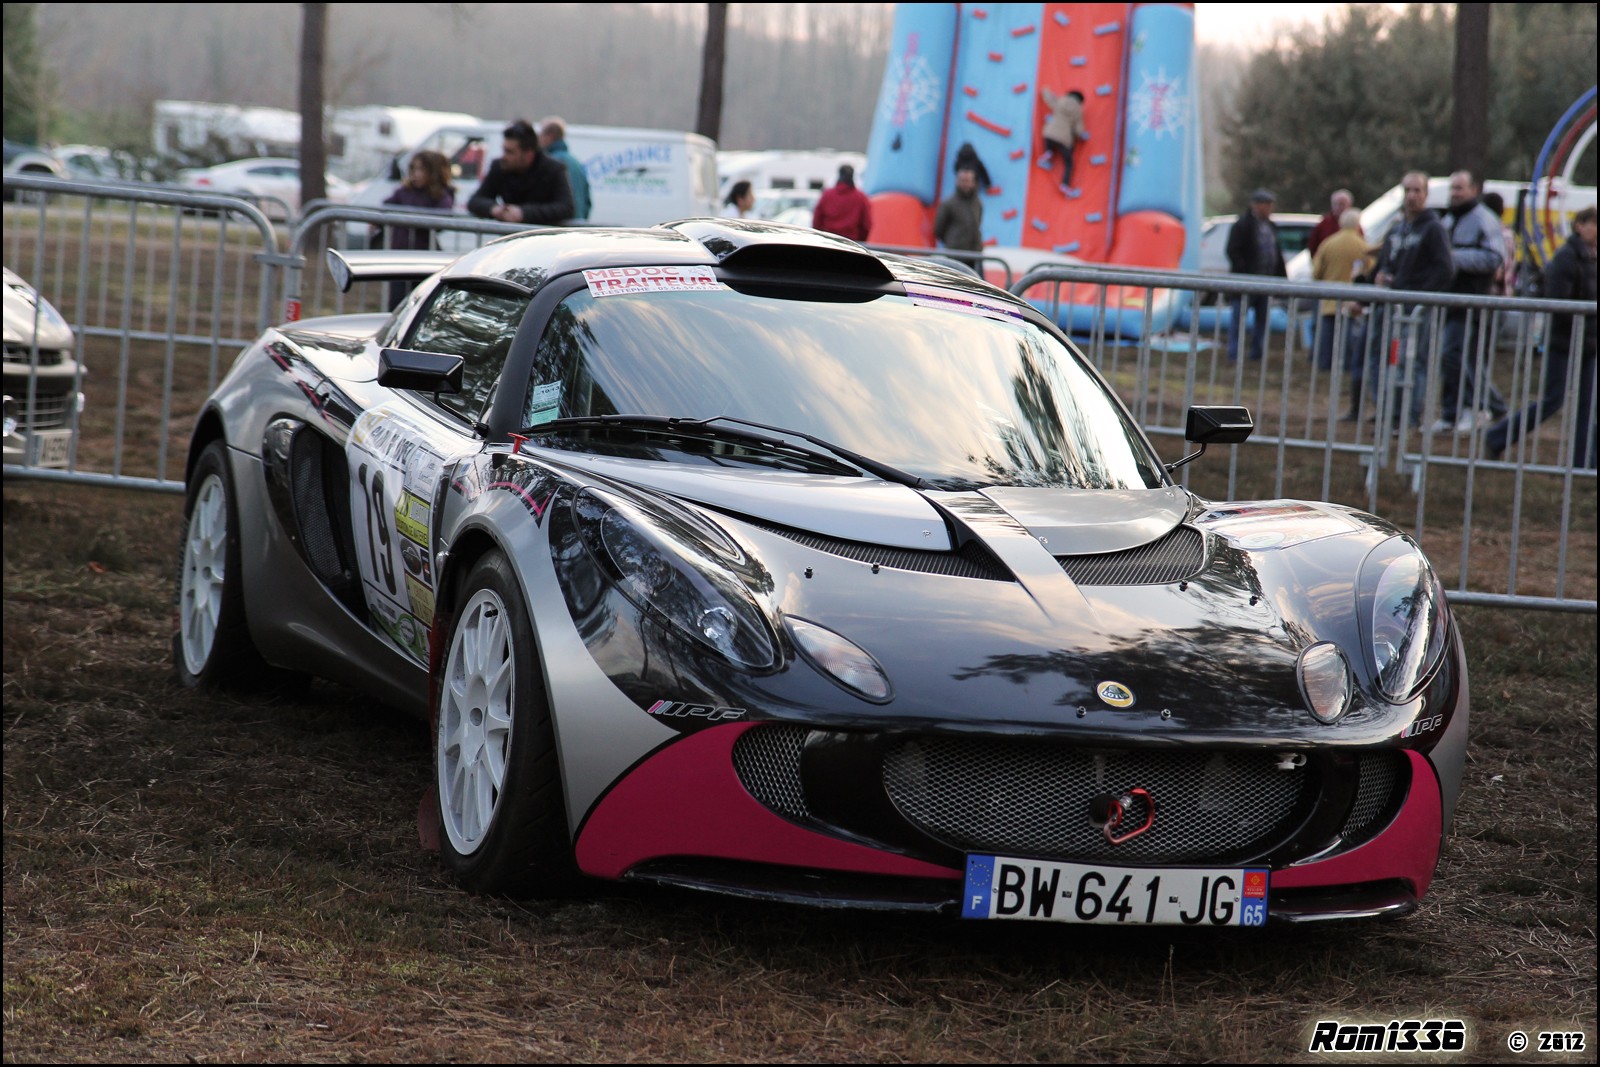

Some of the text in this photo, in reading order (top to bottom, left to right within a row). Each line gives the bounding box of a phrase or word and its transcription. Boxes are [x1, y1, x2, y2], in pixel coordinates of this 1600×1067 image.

[586, 267, 680, 280] MEDOC
[589, 277, 716, 291] TRAITEUR
[359, 462, 397, 596] 19
[971, 896, 983, 910] F
[1244, 905, 1263, 926] 65
